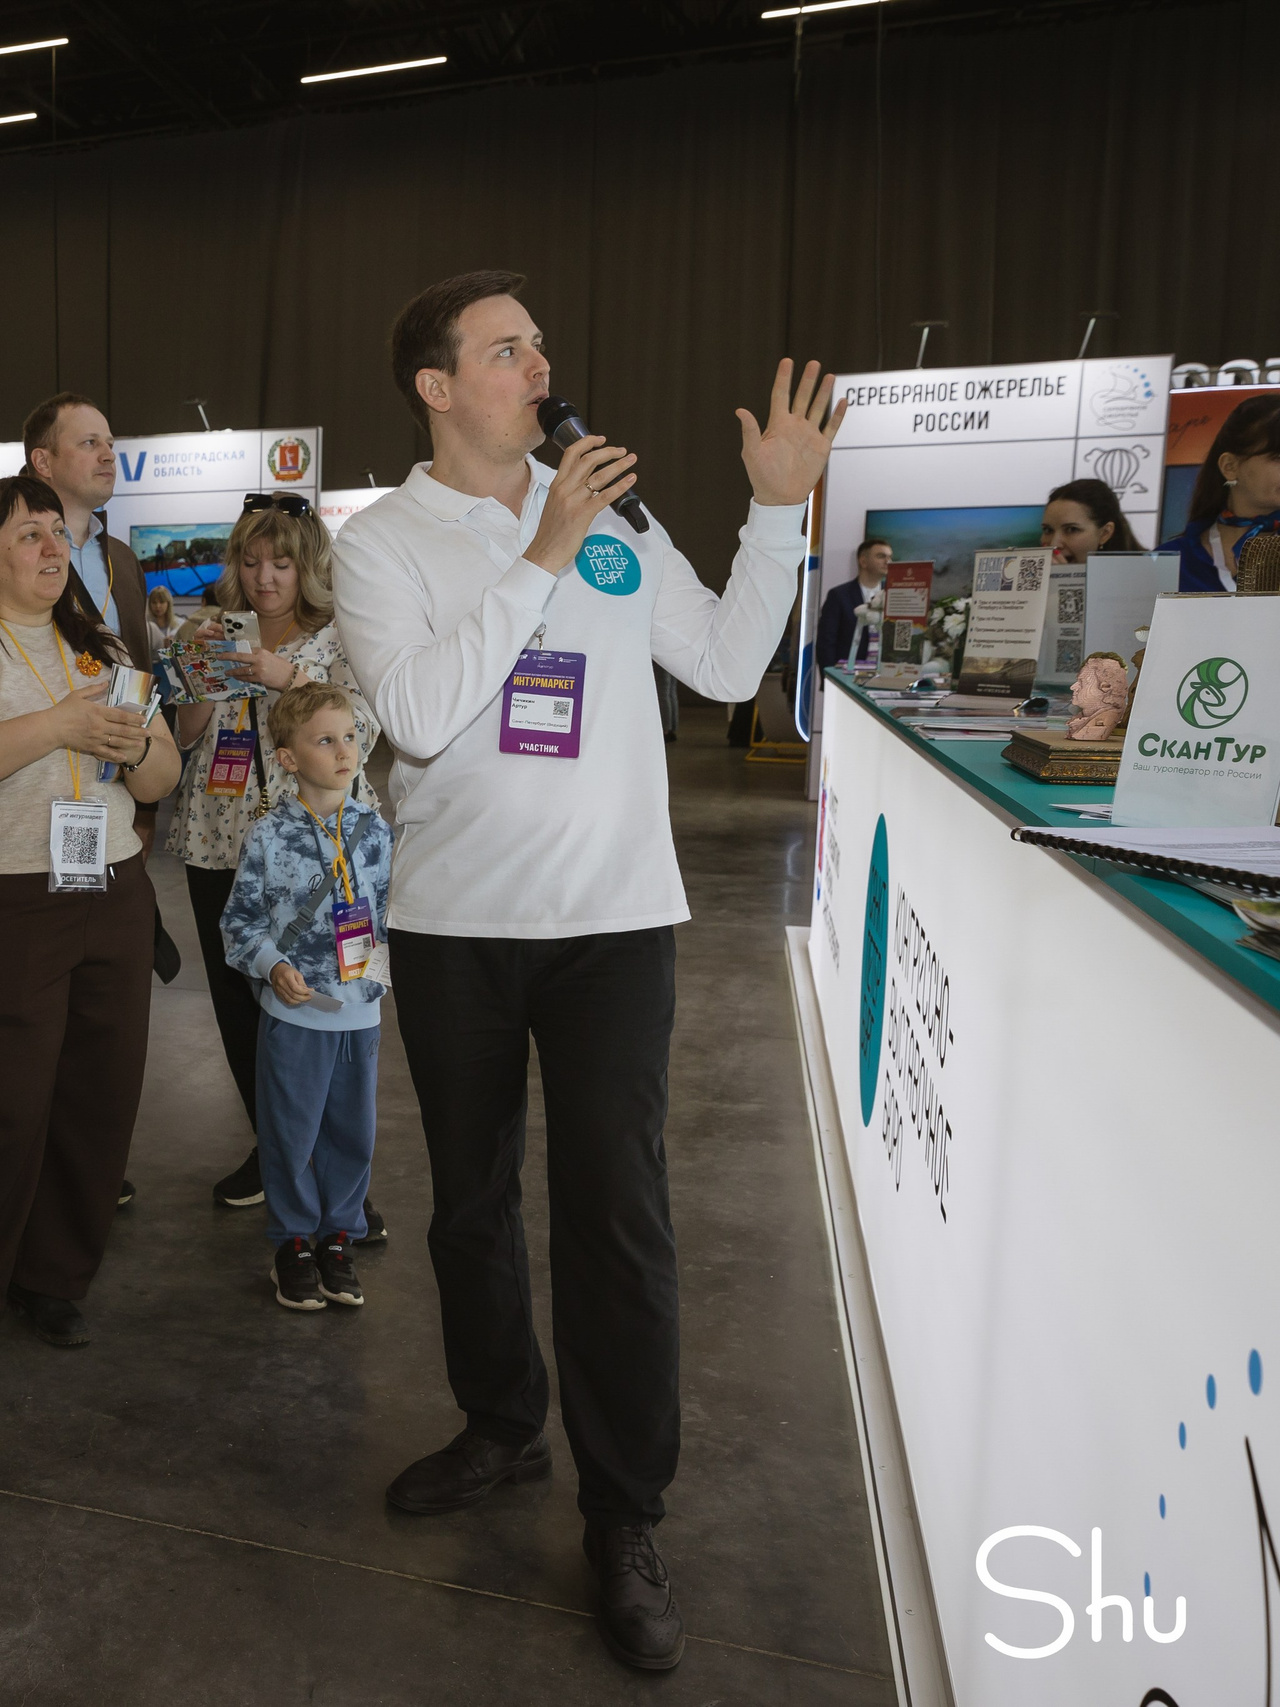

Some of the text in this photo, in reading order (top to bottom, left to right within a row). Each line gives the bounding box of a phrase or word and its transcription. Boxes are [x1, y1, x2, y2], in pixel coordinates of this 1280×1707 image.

[846, 376, 1068, 407] СЕРЕБРЯНОЕ ОЖЕРЕЛЬЕ
[913, 410, 990, 433] РОССИИ
[153, 450, 246, 464] ВОЛГОГРАДСКАЯ
[153, 466, 203, 477] ОБЛАСТЬ
[584, 544, 625, 558] САНКТ
[589, 557, 629, 572] ПЕТЕР
[595, 571, 625, 586] БУРГ
[513, 676, 575, 690] ИНТУРМАРКЕТ
[519, 742, 559, 754] УЧАСТНИК
[1133, 762, 1262, 779] Ваш туроператор по России
[61, 875, 96, 883] ОСЕТИТЕЛЬ
[888, 977, 952, 1224] ВЫСТАВОЧНОЕ
